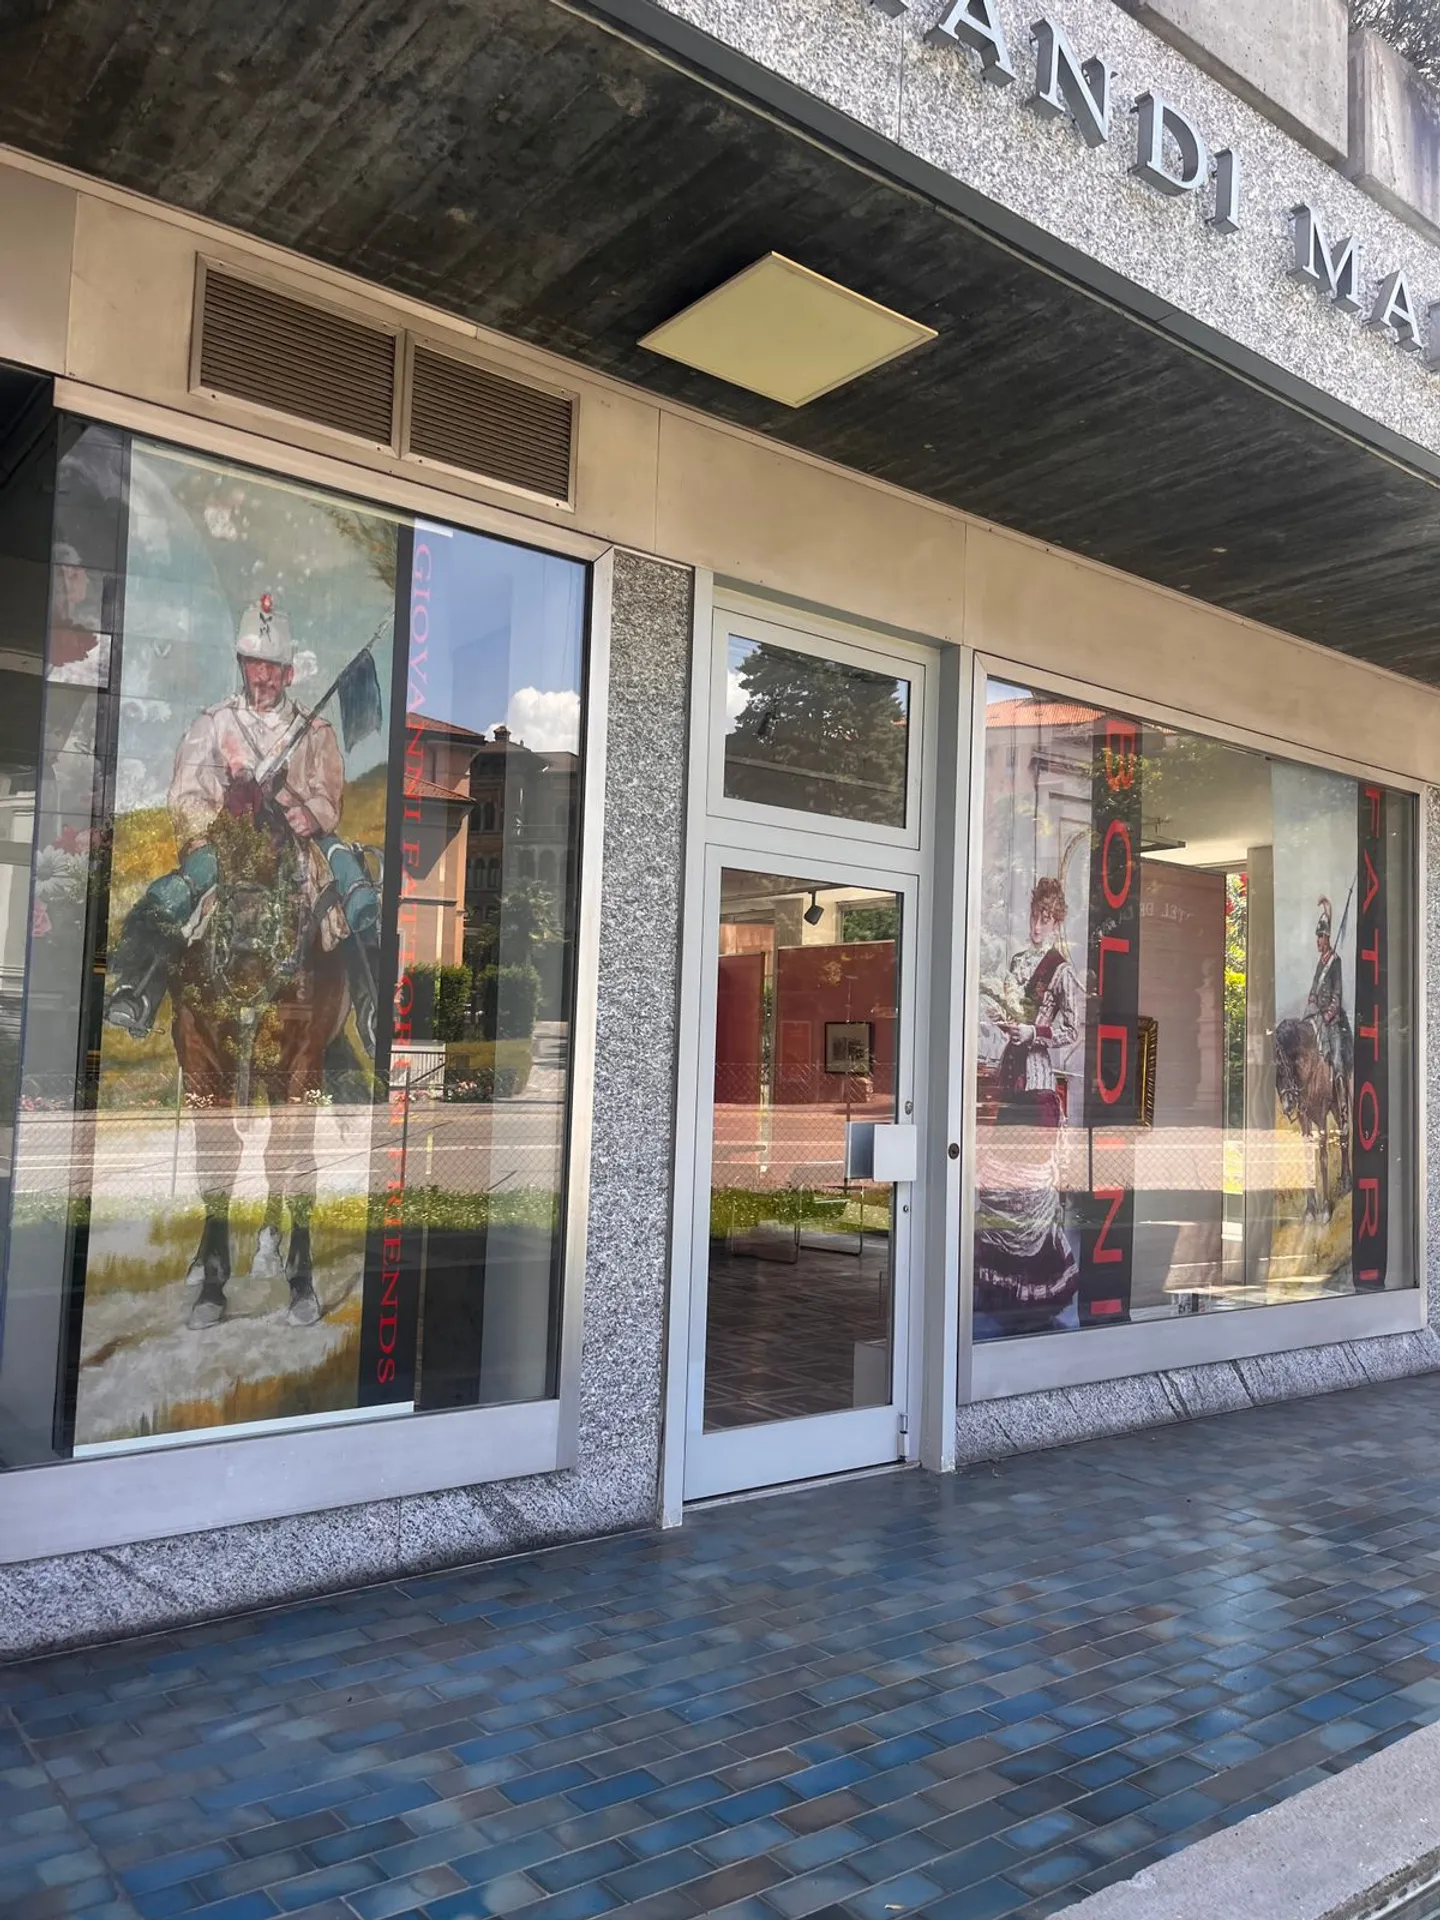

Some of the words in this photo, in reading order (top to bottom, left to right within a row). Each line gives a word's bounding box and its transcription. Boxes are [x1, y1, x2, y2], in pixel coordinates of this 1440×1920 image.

[870, 0, 1239, 233] ANDI
[1288, 203, 1440, 371] MA
[403, 543, 433, 824] GIOVANNI
[392, 841, 420, 1068] FATTORI
[1091, 719, 1136, 1315] BOLDINI
[1357, 788, 1386, 1281] FATTORI
[376, 1148, 407, 1383] FRIENDS
